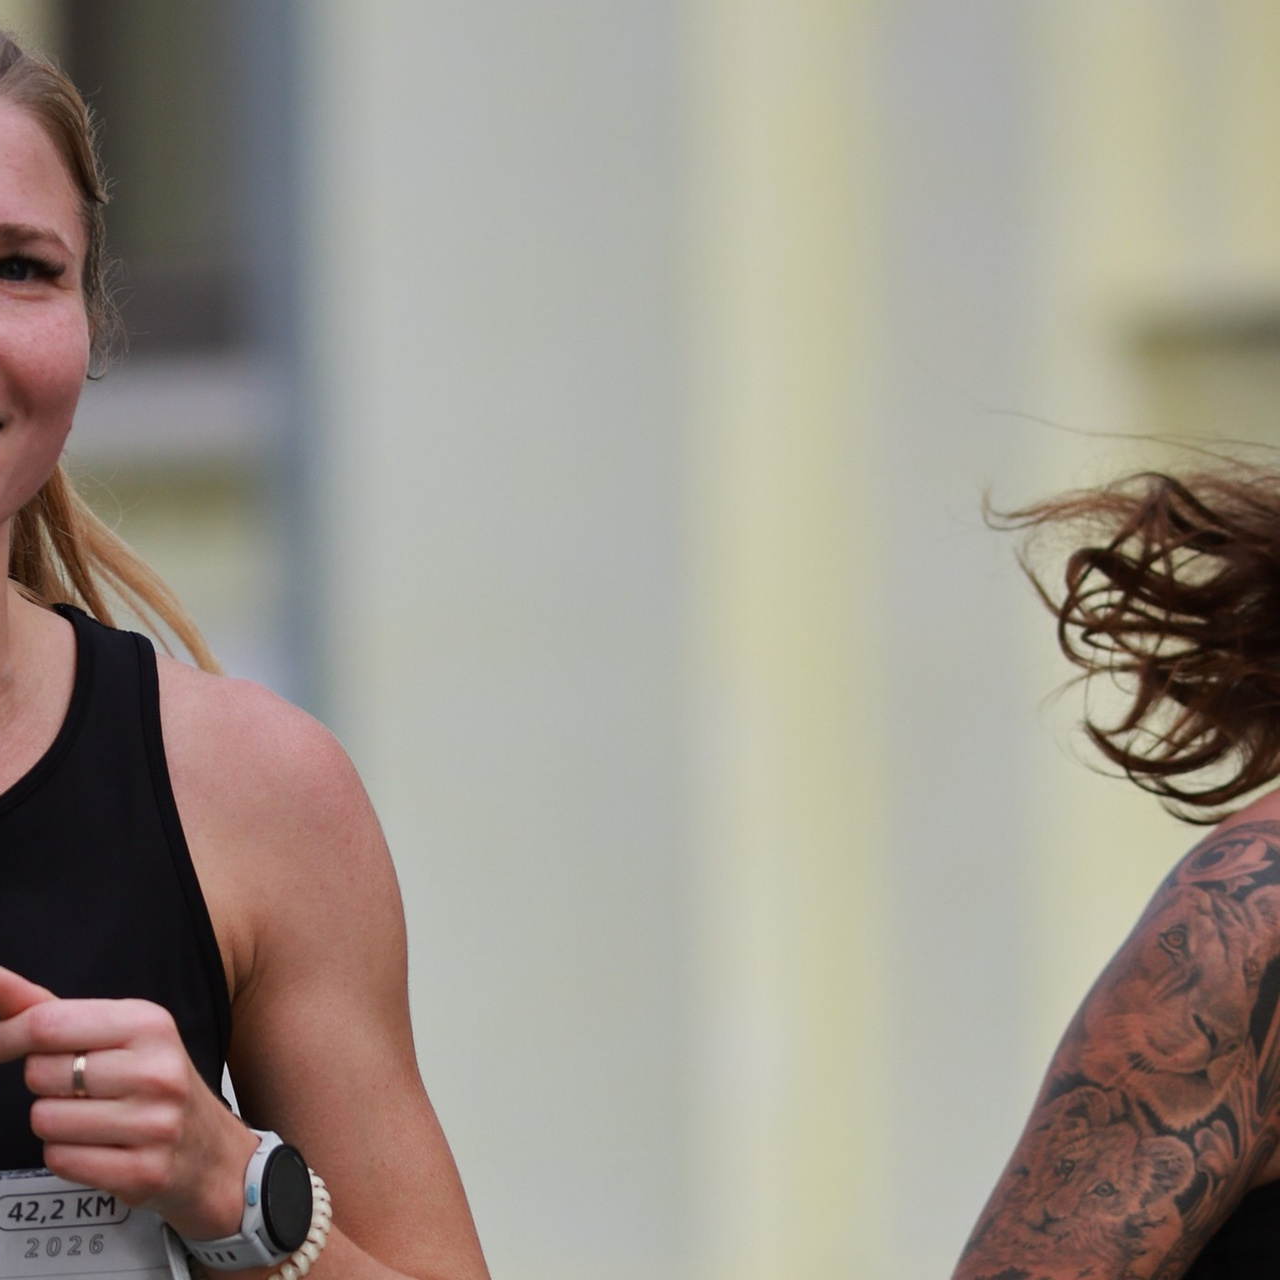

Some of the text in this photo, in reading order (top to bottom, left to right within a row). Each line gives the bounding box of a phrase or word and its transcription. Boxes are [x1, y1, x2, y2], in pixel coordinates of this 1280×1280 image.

[7, 1196, 116, 1224] 42,2 КМ
[24, 1234, 105, 1259] 2026
